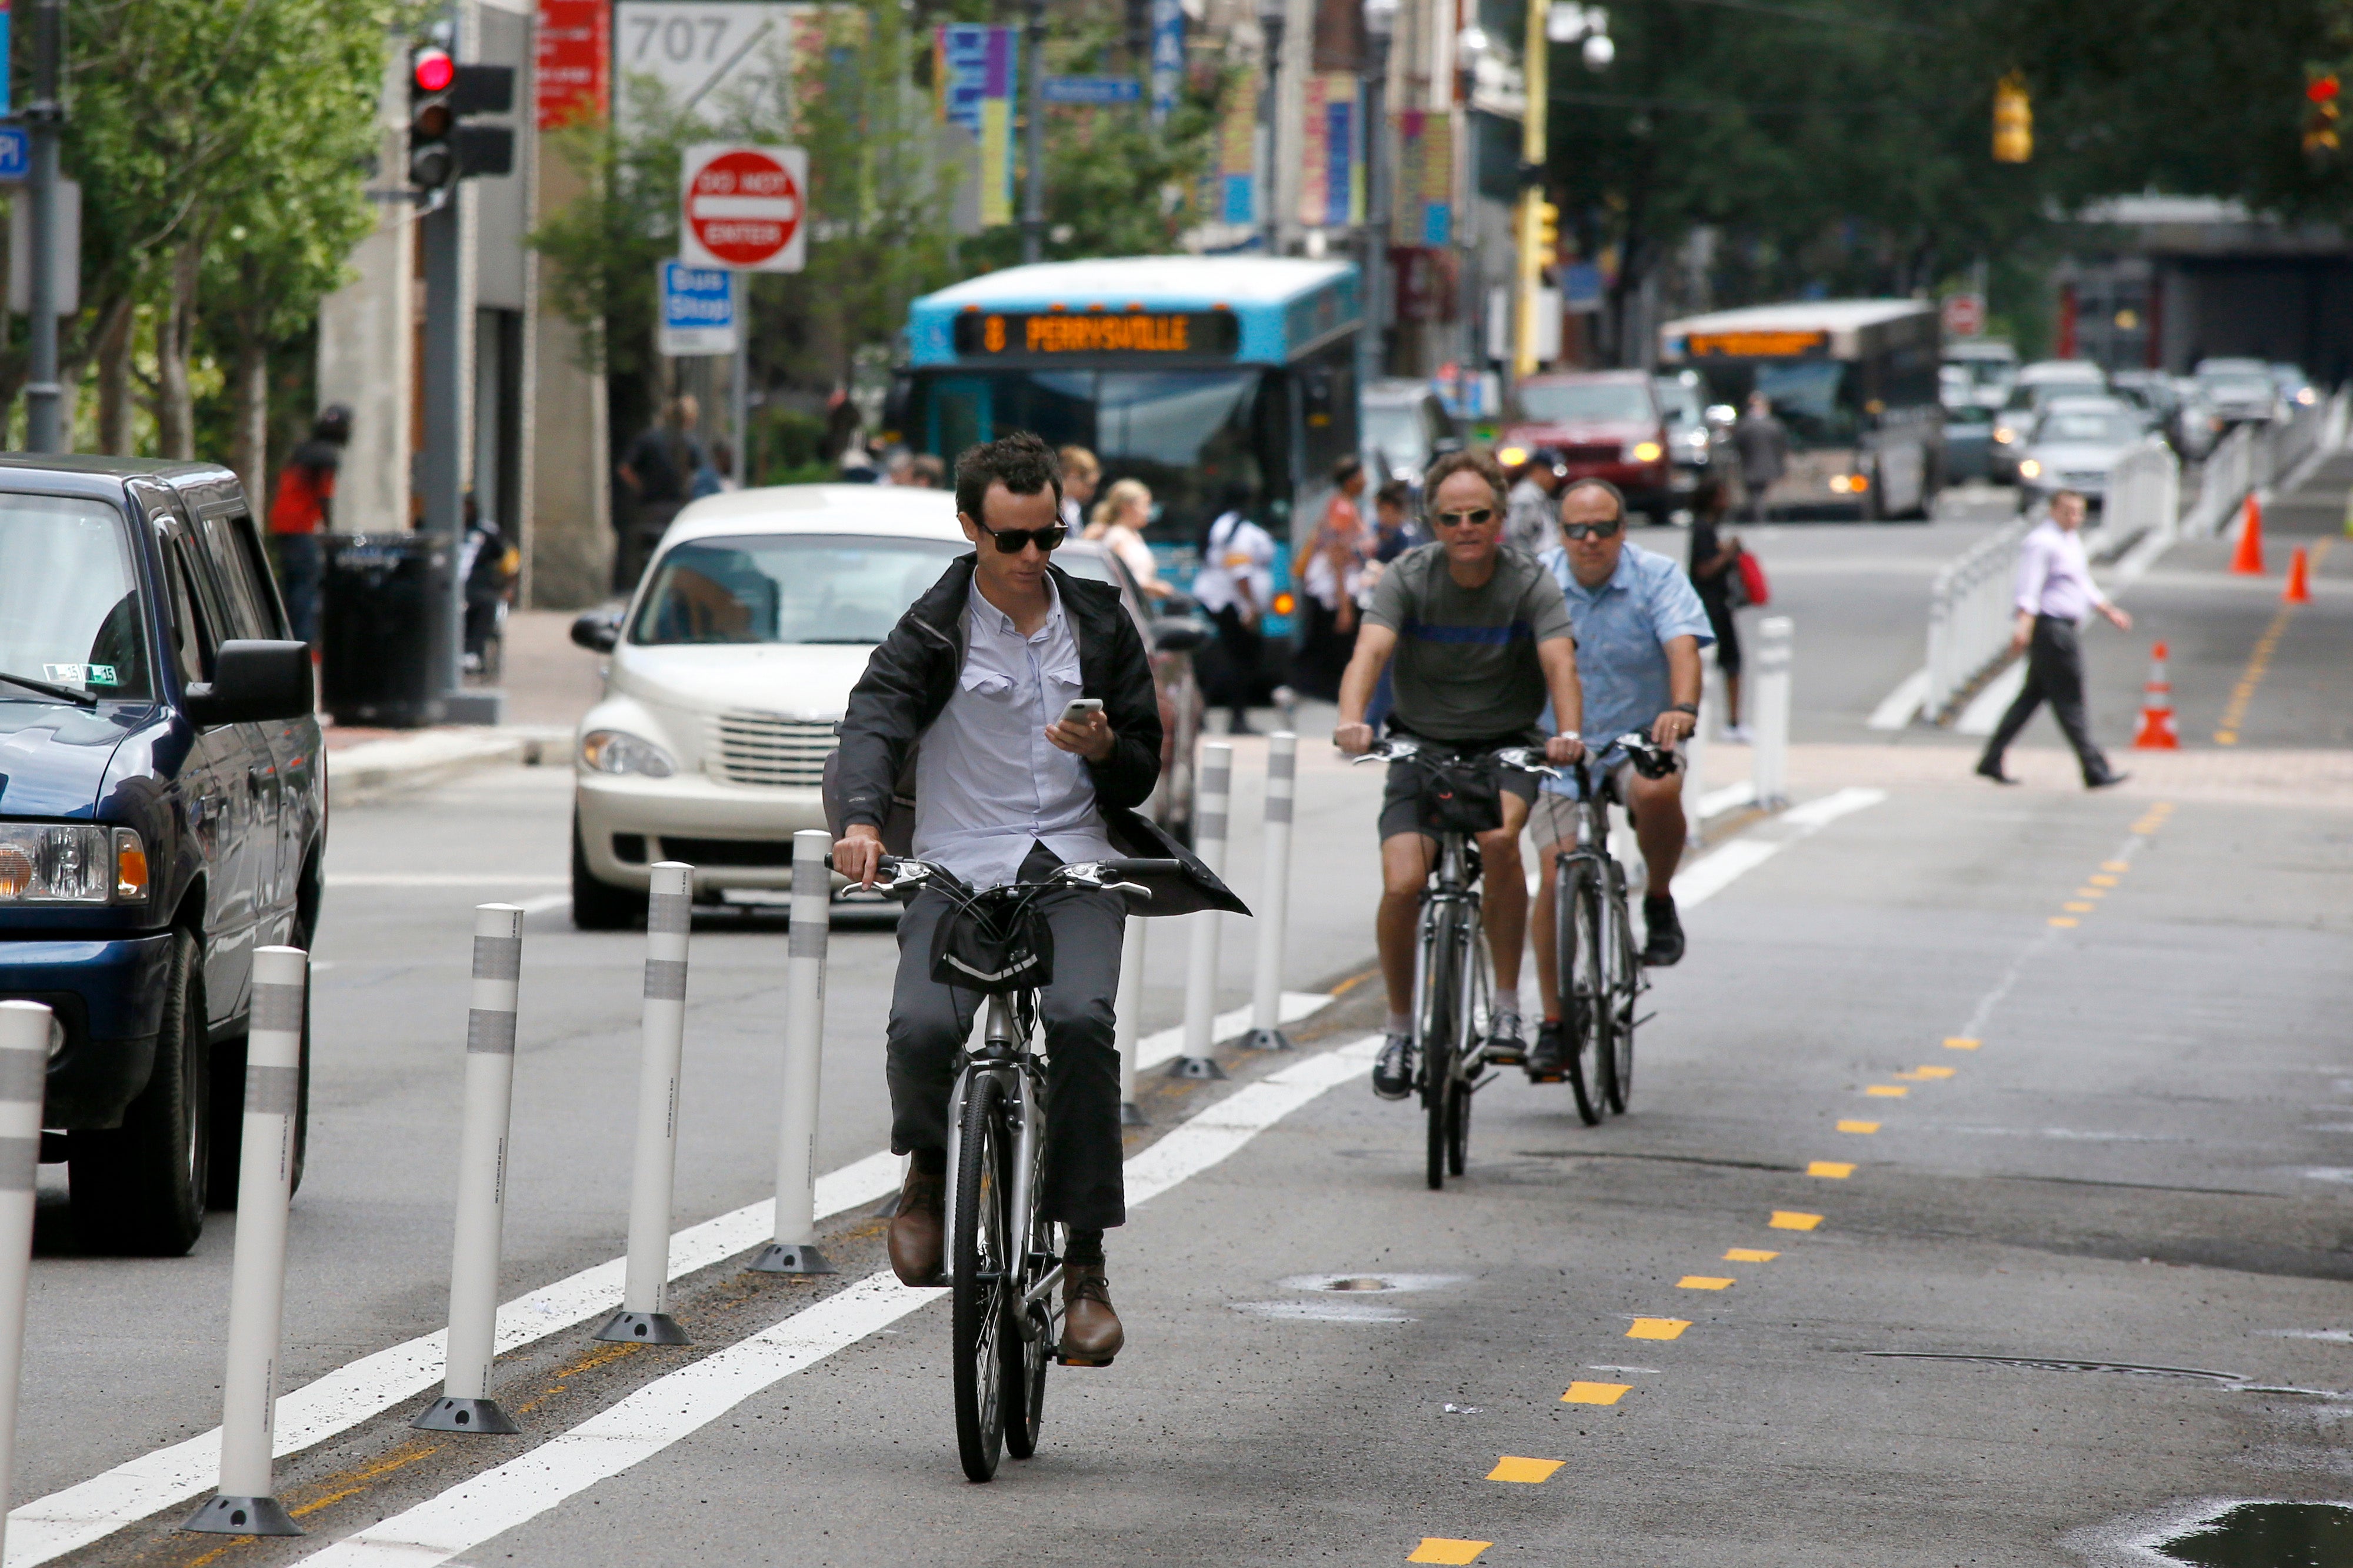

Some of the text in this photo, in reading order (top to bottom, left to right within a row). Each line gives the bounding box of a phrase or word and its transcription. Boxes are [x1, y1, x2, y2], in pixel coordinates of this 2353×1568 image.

[630, 16, 731, 61] 707
[697, 169, 787, 194] DO NOT
[705, 222, 783, 246] ENTER
[668, 295, 731, 321] Stop
[984, 315, 1189, 352] 8 PERRYSVILLE
[103, 666, 114, 681] 15
